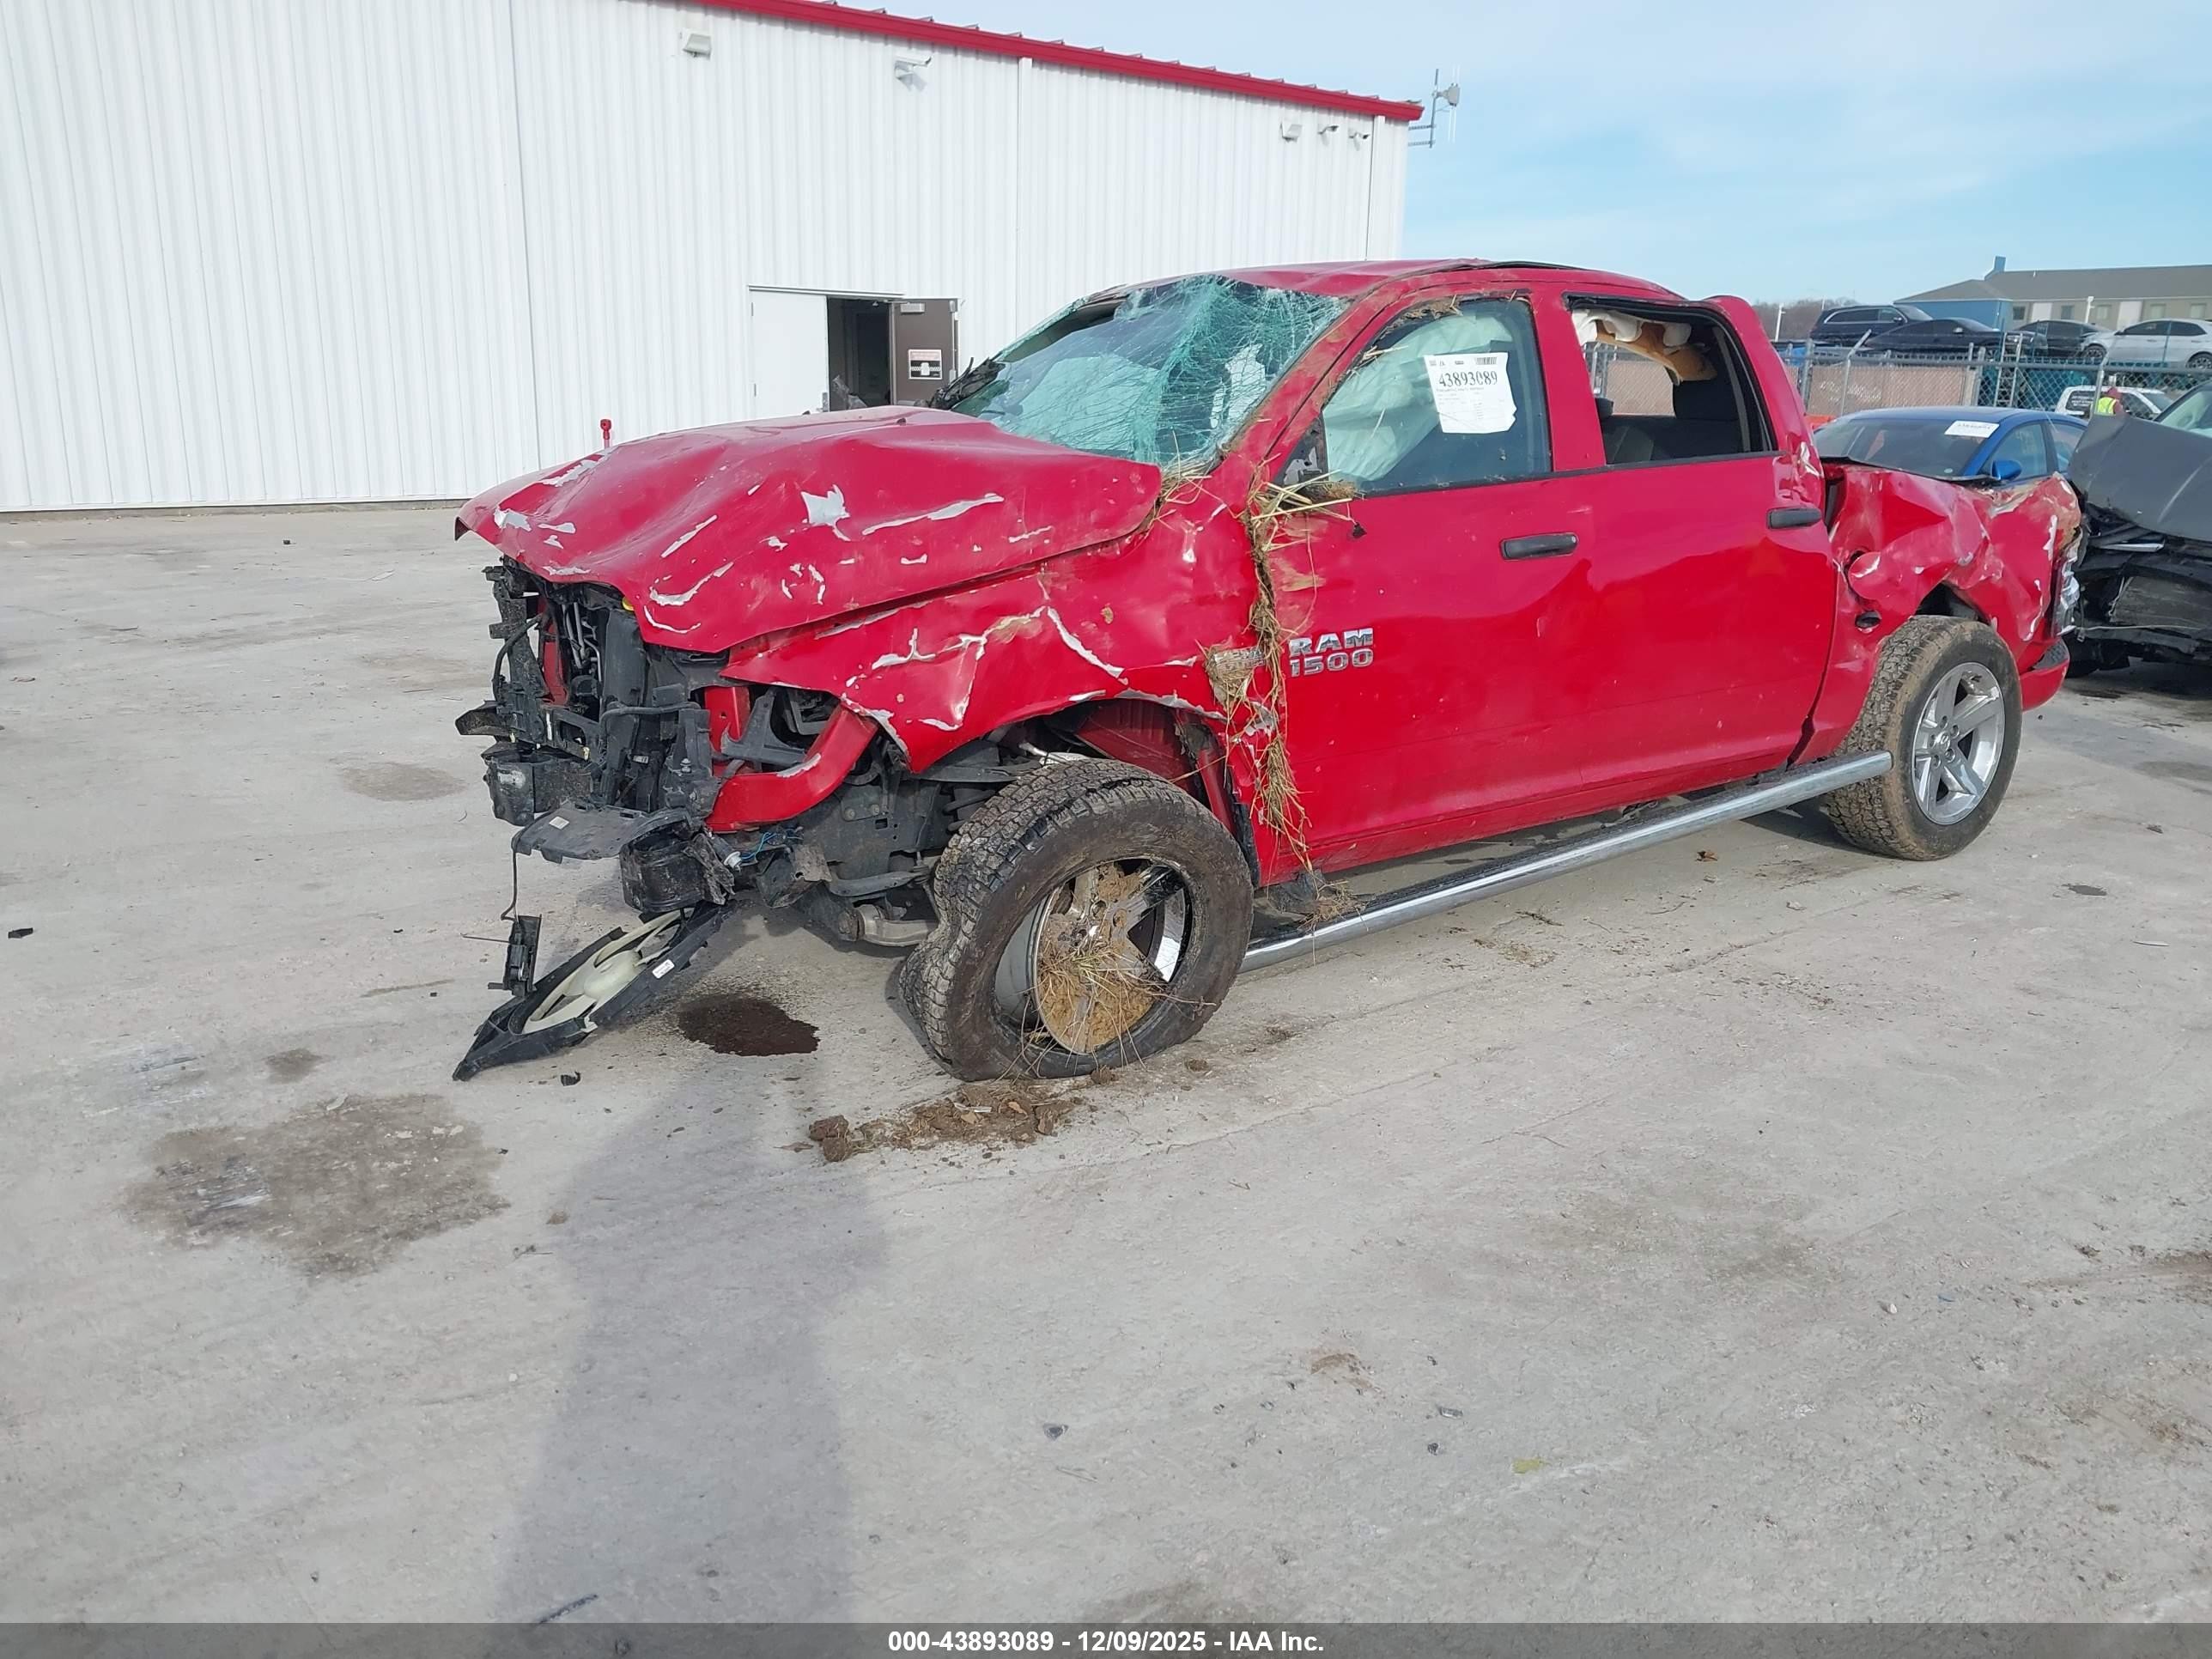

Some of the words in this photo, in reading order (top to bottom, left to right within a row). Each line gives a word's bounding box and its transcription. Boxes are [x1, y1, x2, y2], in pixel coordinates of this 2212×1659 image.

[1438, 370, 1498, 386] 43893089
[1289, 628, 1374, 657] RAM
[1290, 648, 1374, 677] 1500
